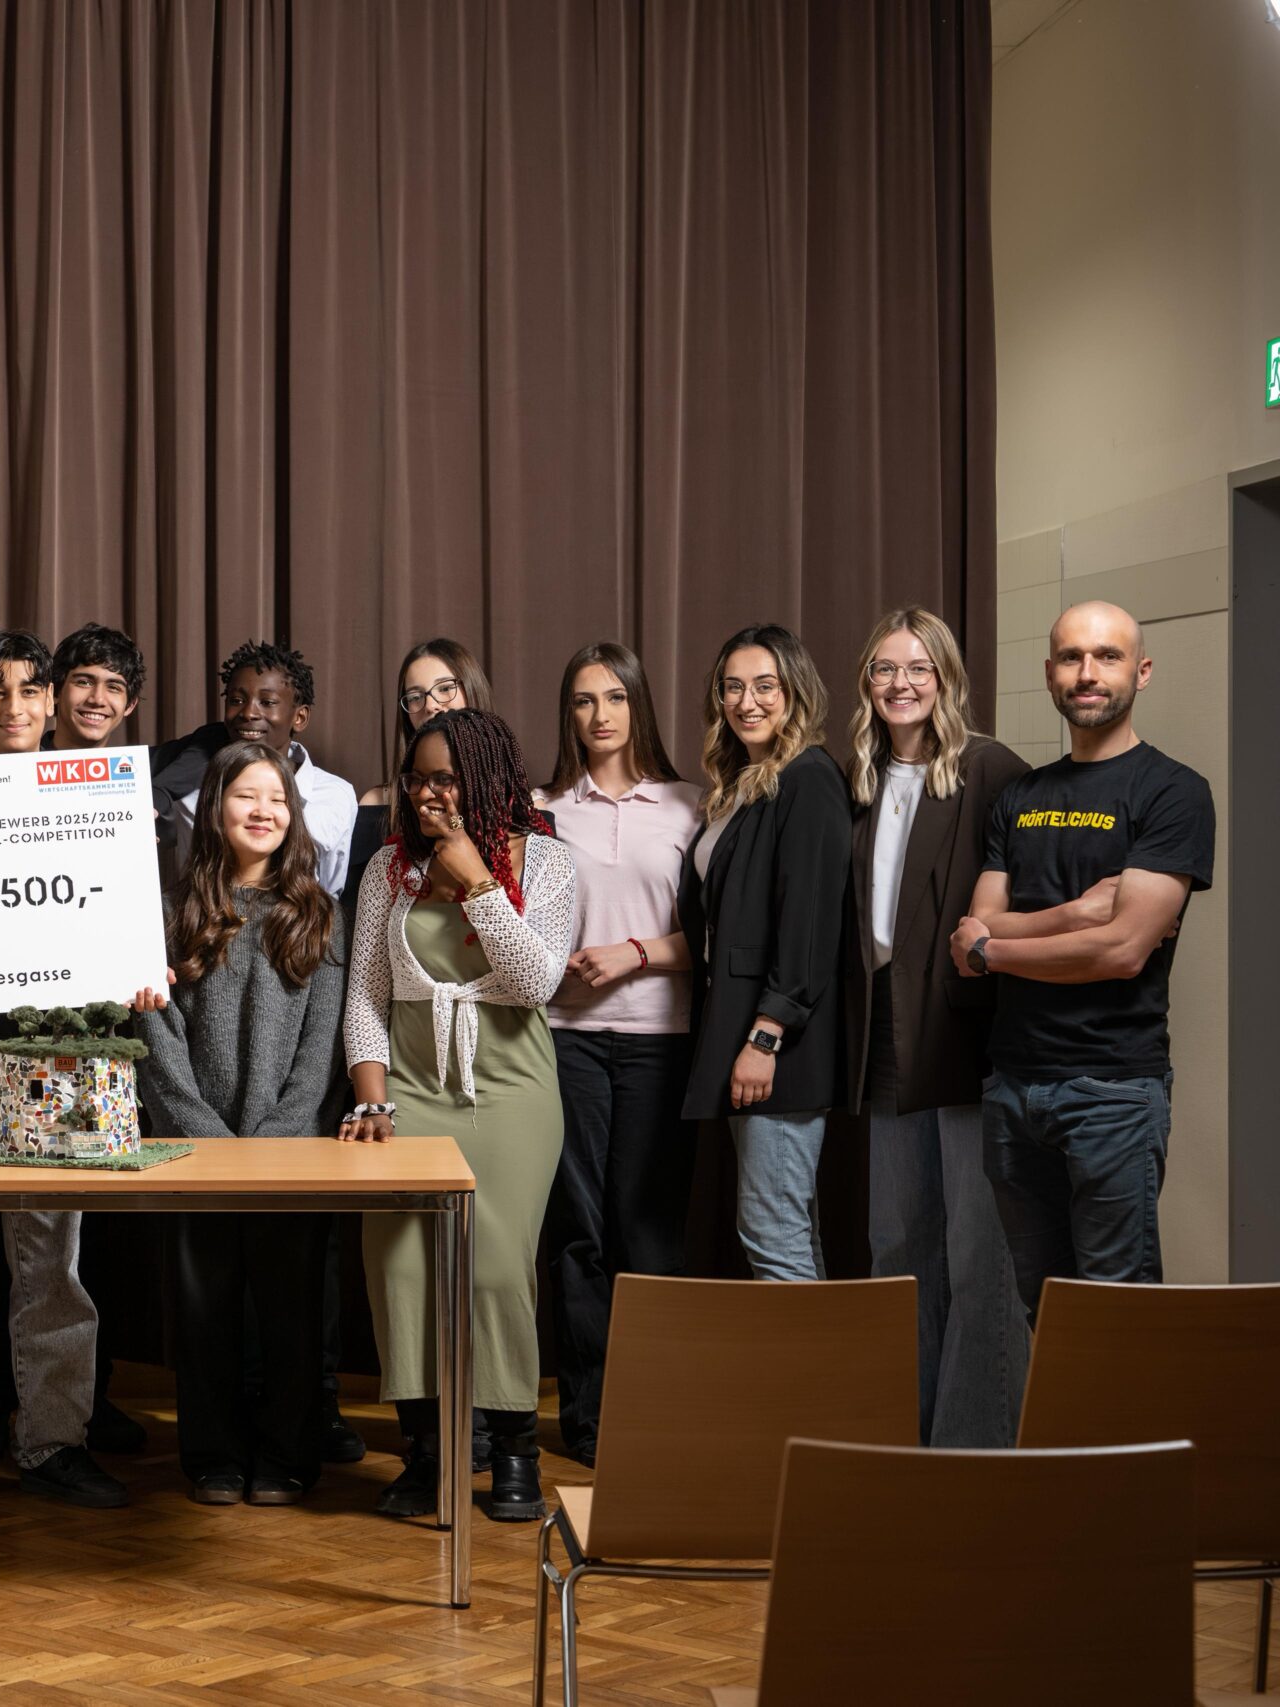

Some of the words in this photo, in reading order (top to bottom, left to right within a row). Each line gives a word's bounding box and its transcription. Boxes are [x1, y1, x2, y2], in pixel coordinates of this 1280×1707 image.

[38, 761, 106, 782] WKO
[55, 811, 133, 826] 2025/2026
[1017, 810, 1115, 830] MÖRTELICIOUS
